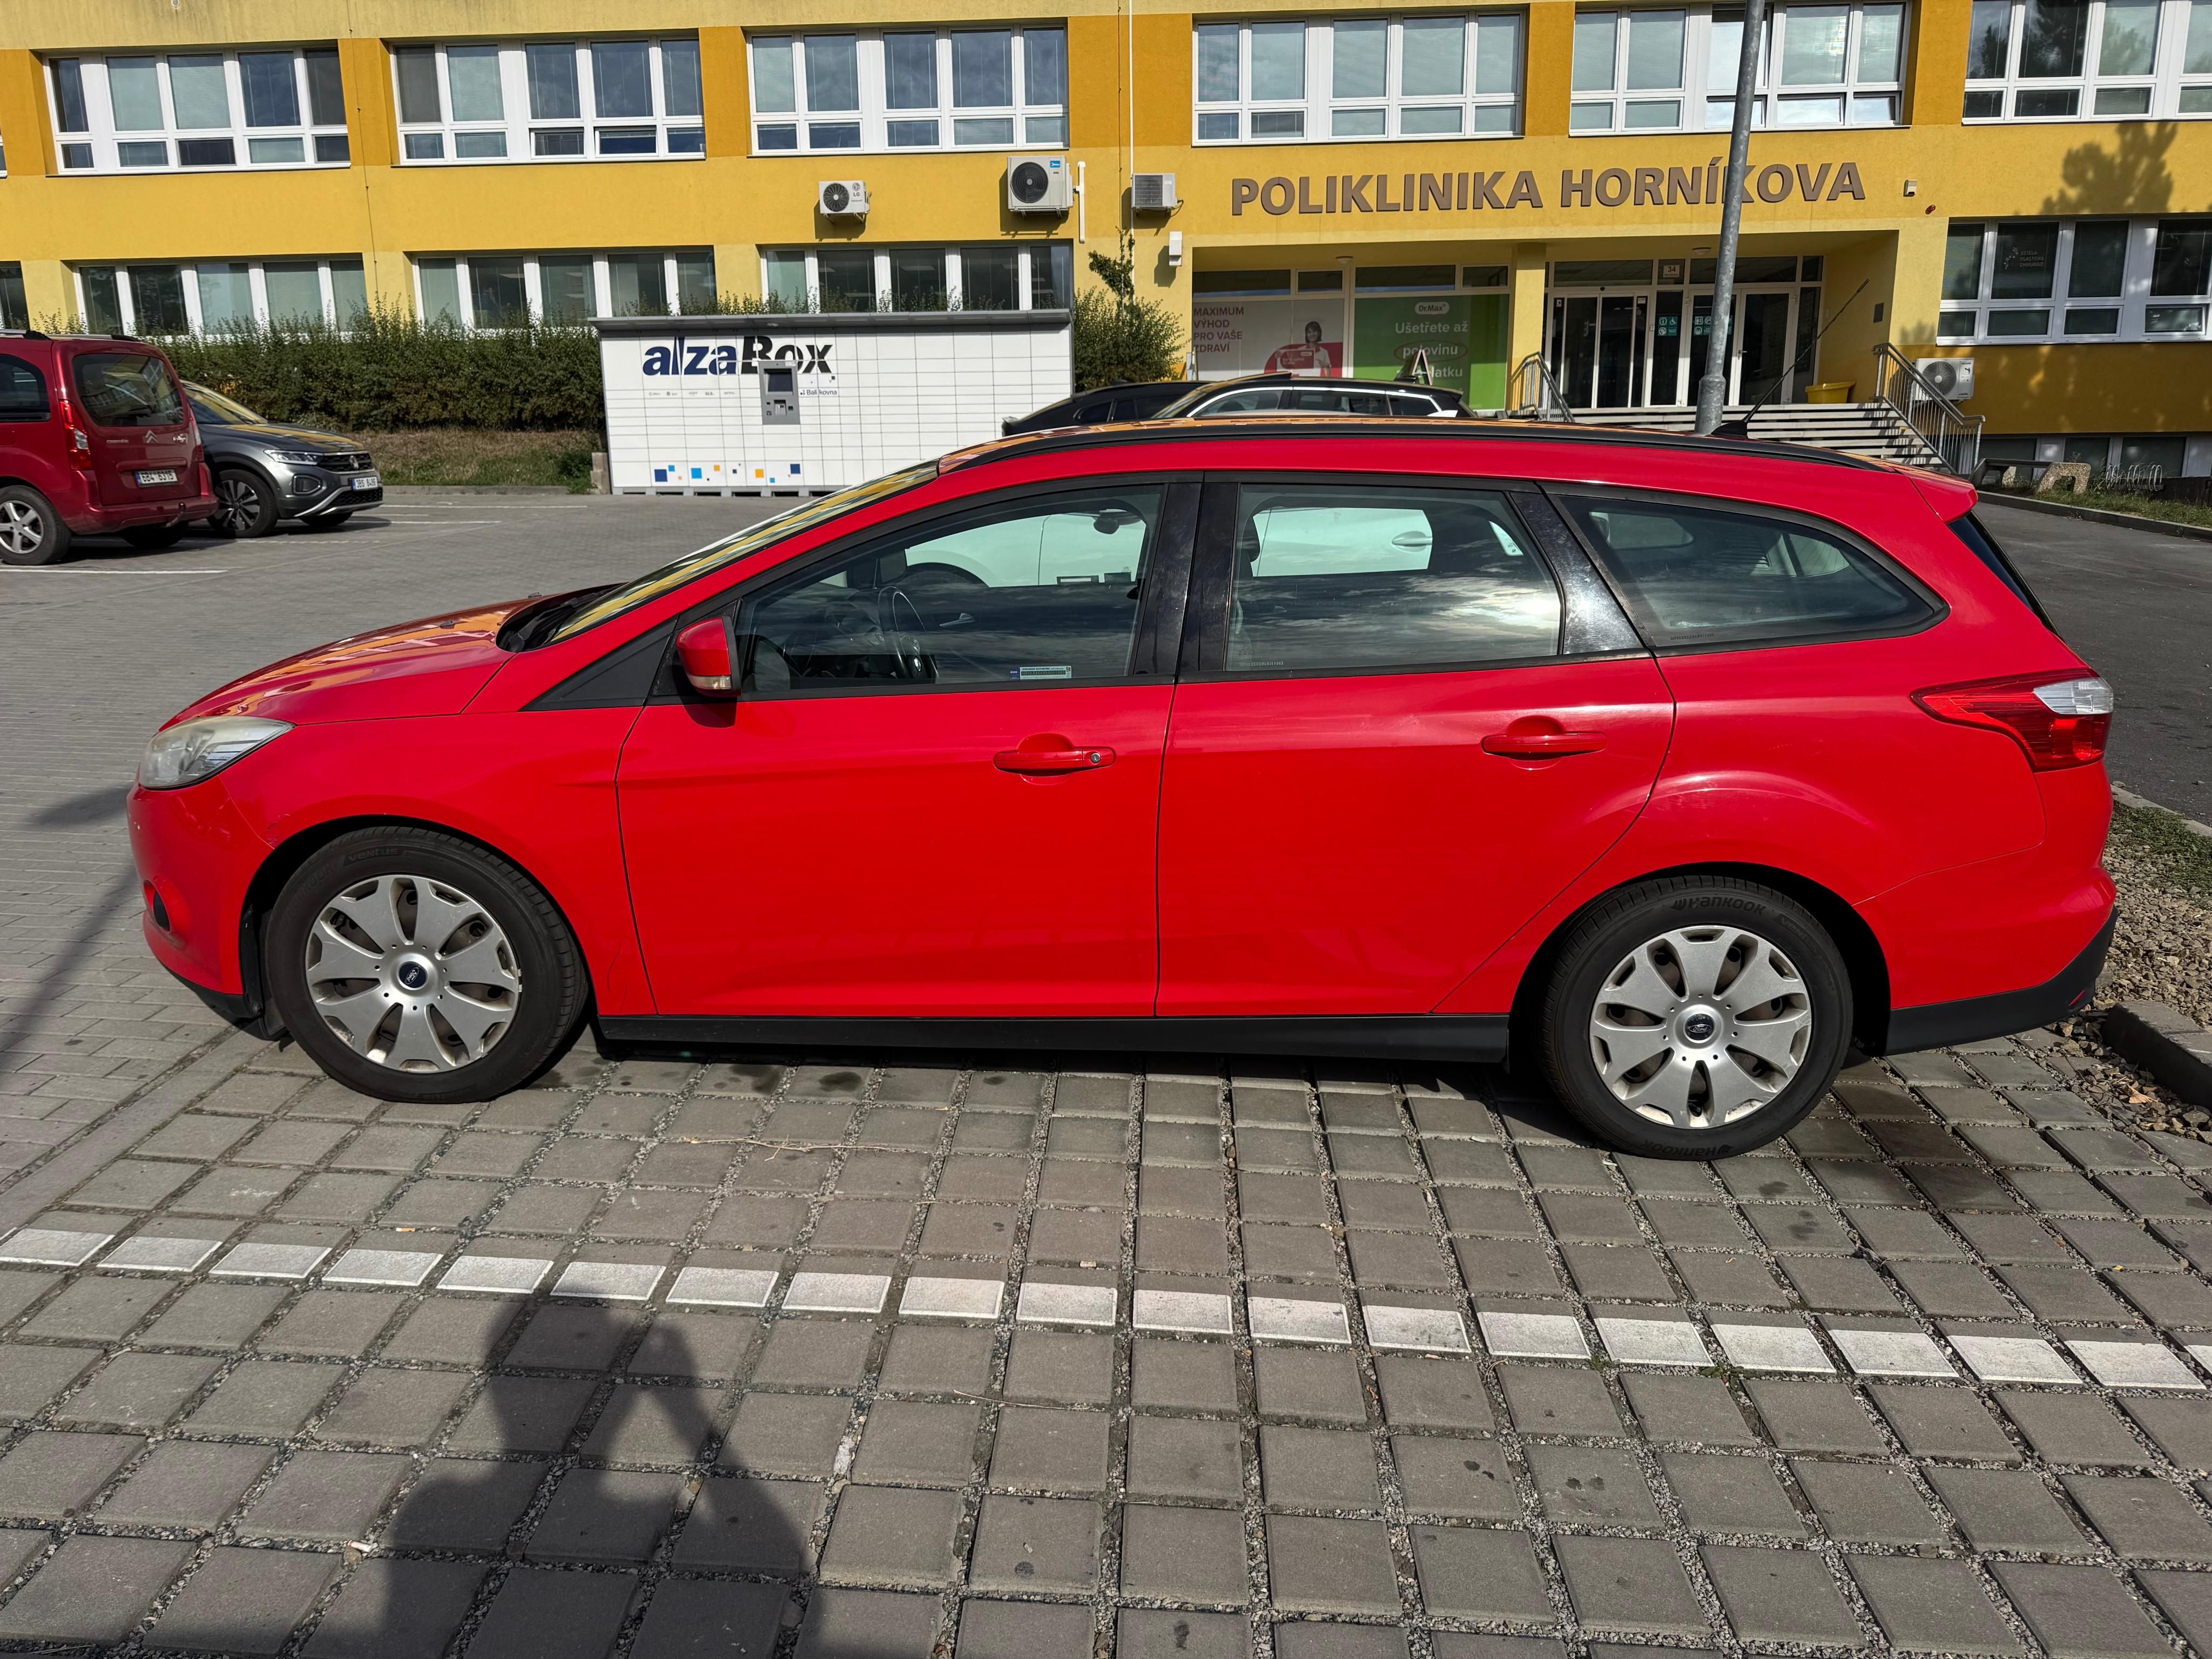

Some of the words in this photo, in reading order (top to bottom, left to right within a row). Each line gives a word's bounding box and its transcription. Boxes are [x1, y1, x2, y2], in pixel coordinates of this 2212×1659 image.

[1232, 171, 1543, 215] POLIKLINIKA
[1561, 157, 1866, 207] HORNÍKOVA
[1193, 307, 1244, 316] MAXIMUM
[1193, 318, 1230, 329] VÝHOD
[1395, 321, 1450, 334] Ušetřete
[1454, 321, 1469, 333] až
[1193, 332, 1215, 341] PRO
[1217, 329, 1243, 340] VAŠE
[1194, 341, 1230, 353] ZDRAVÍ
[642, 335, 833, 376] alzaBox
